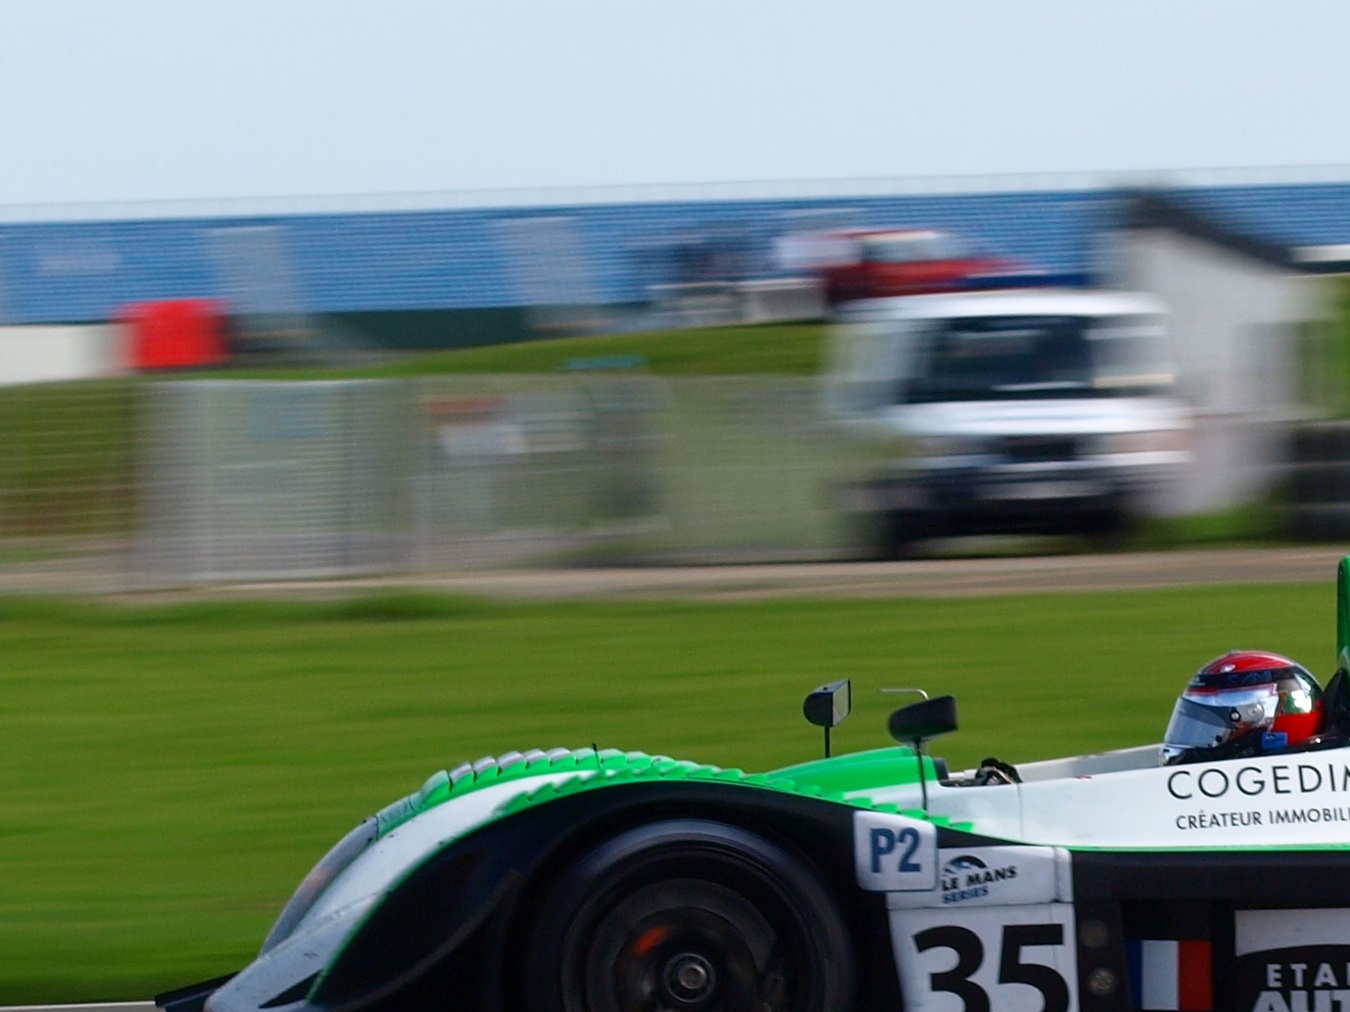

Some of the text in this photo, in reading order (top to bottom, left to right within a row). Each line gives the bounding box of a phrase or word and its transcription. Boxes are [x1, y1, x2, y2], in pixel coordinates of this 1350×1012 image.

[1176, 809, 1263, 830] CRÉATEUR
[870, 827, 921, 873] P2
[941, 865, 1017, 892] LE MANS
[941, 885, 990, 904] SERIES
